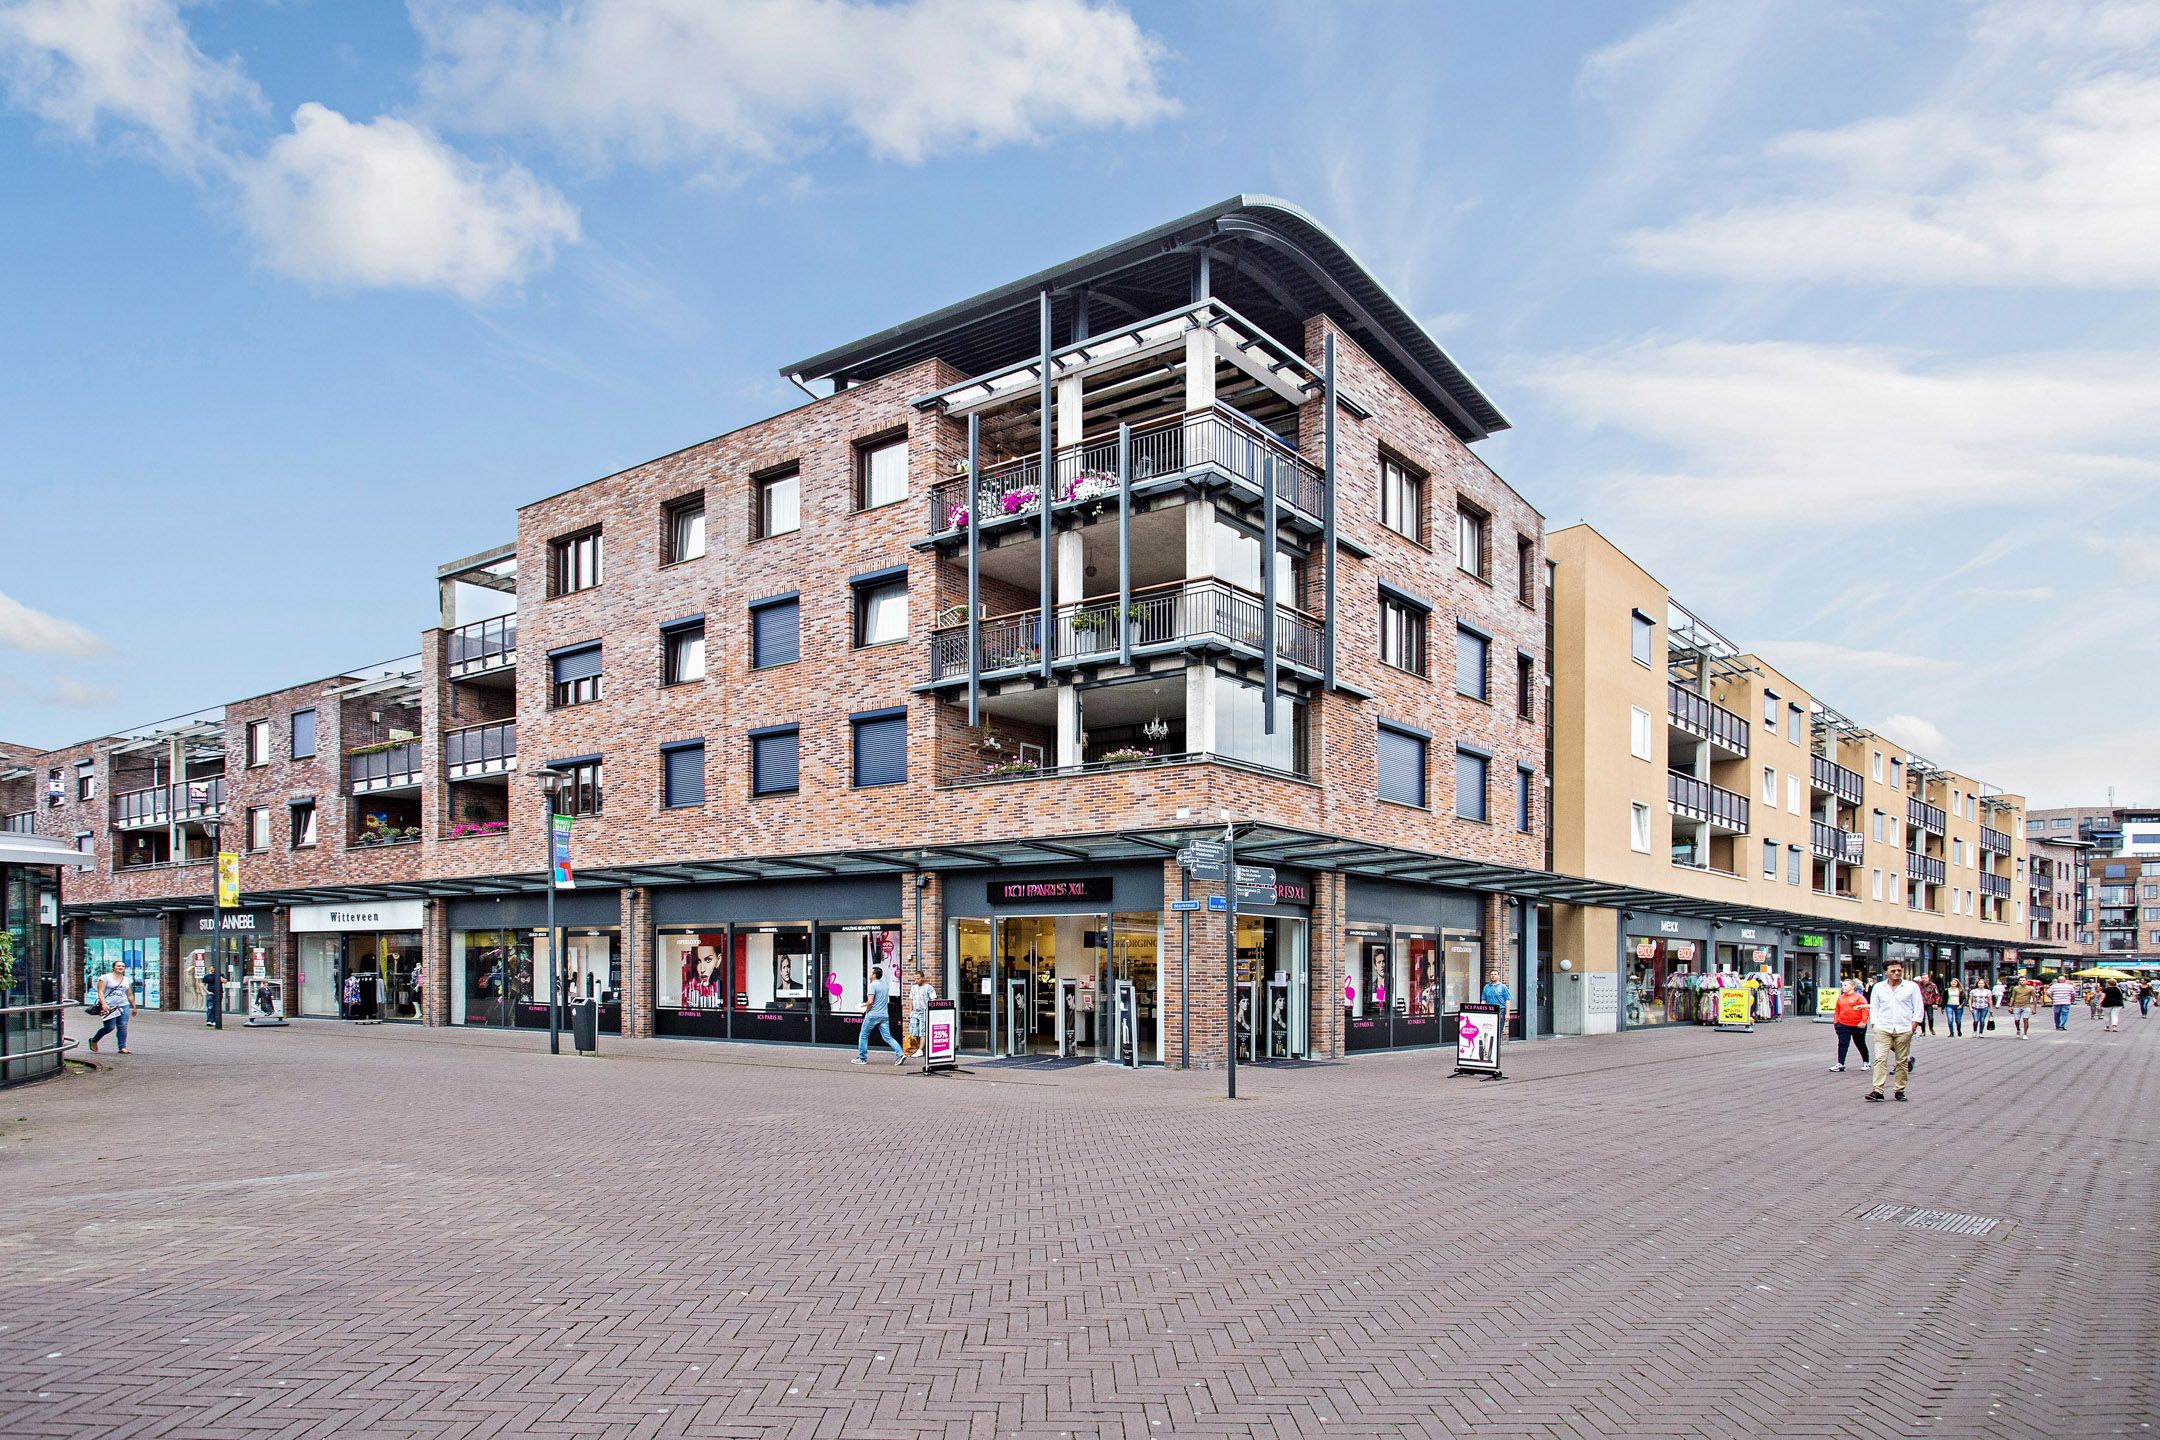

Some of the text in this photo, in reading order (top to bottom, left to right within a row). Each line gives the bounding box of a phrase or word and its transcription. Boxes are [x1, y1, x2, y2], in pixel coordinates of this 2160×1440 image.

[1004, 882, 1087, 898] ICI PARIS XL
[221, 914, 255, 930] ANNEBEL
[330, 911, 379, 922] Witteveen
[933, 1030, 948, 1038] 25%
